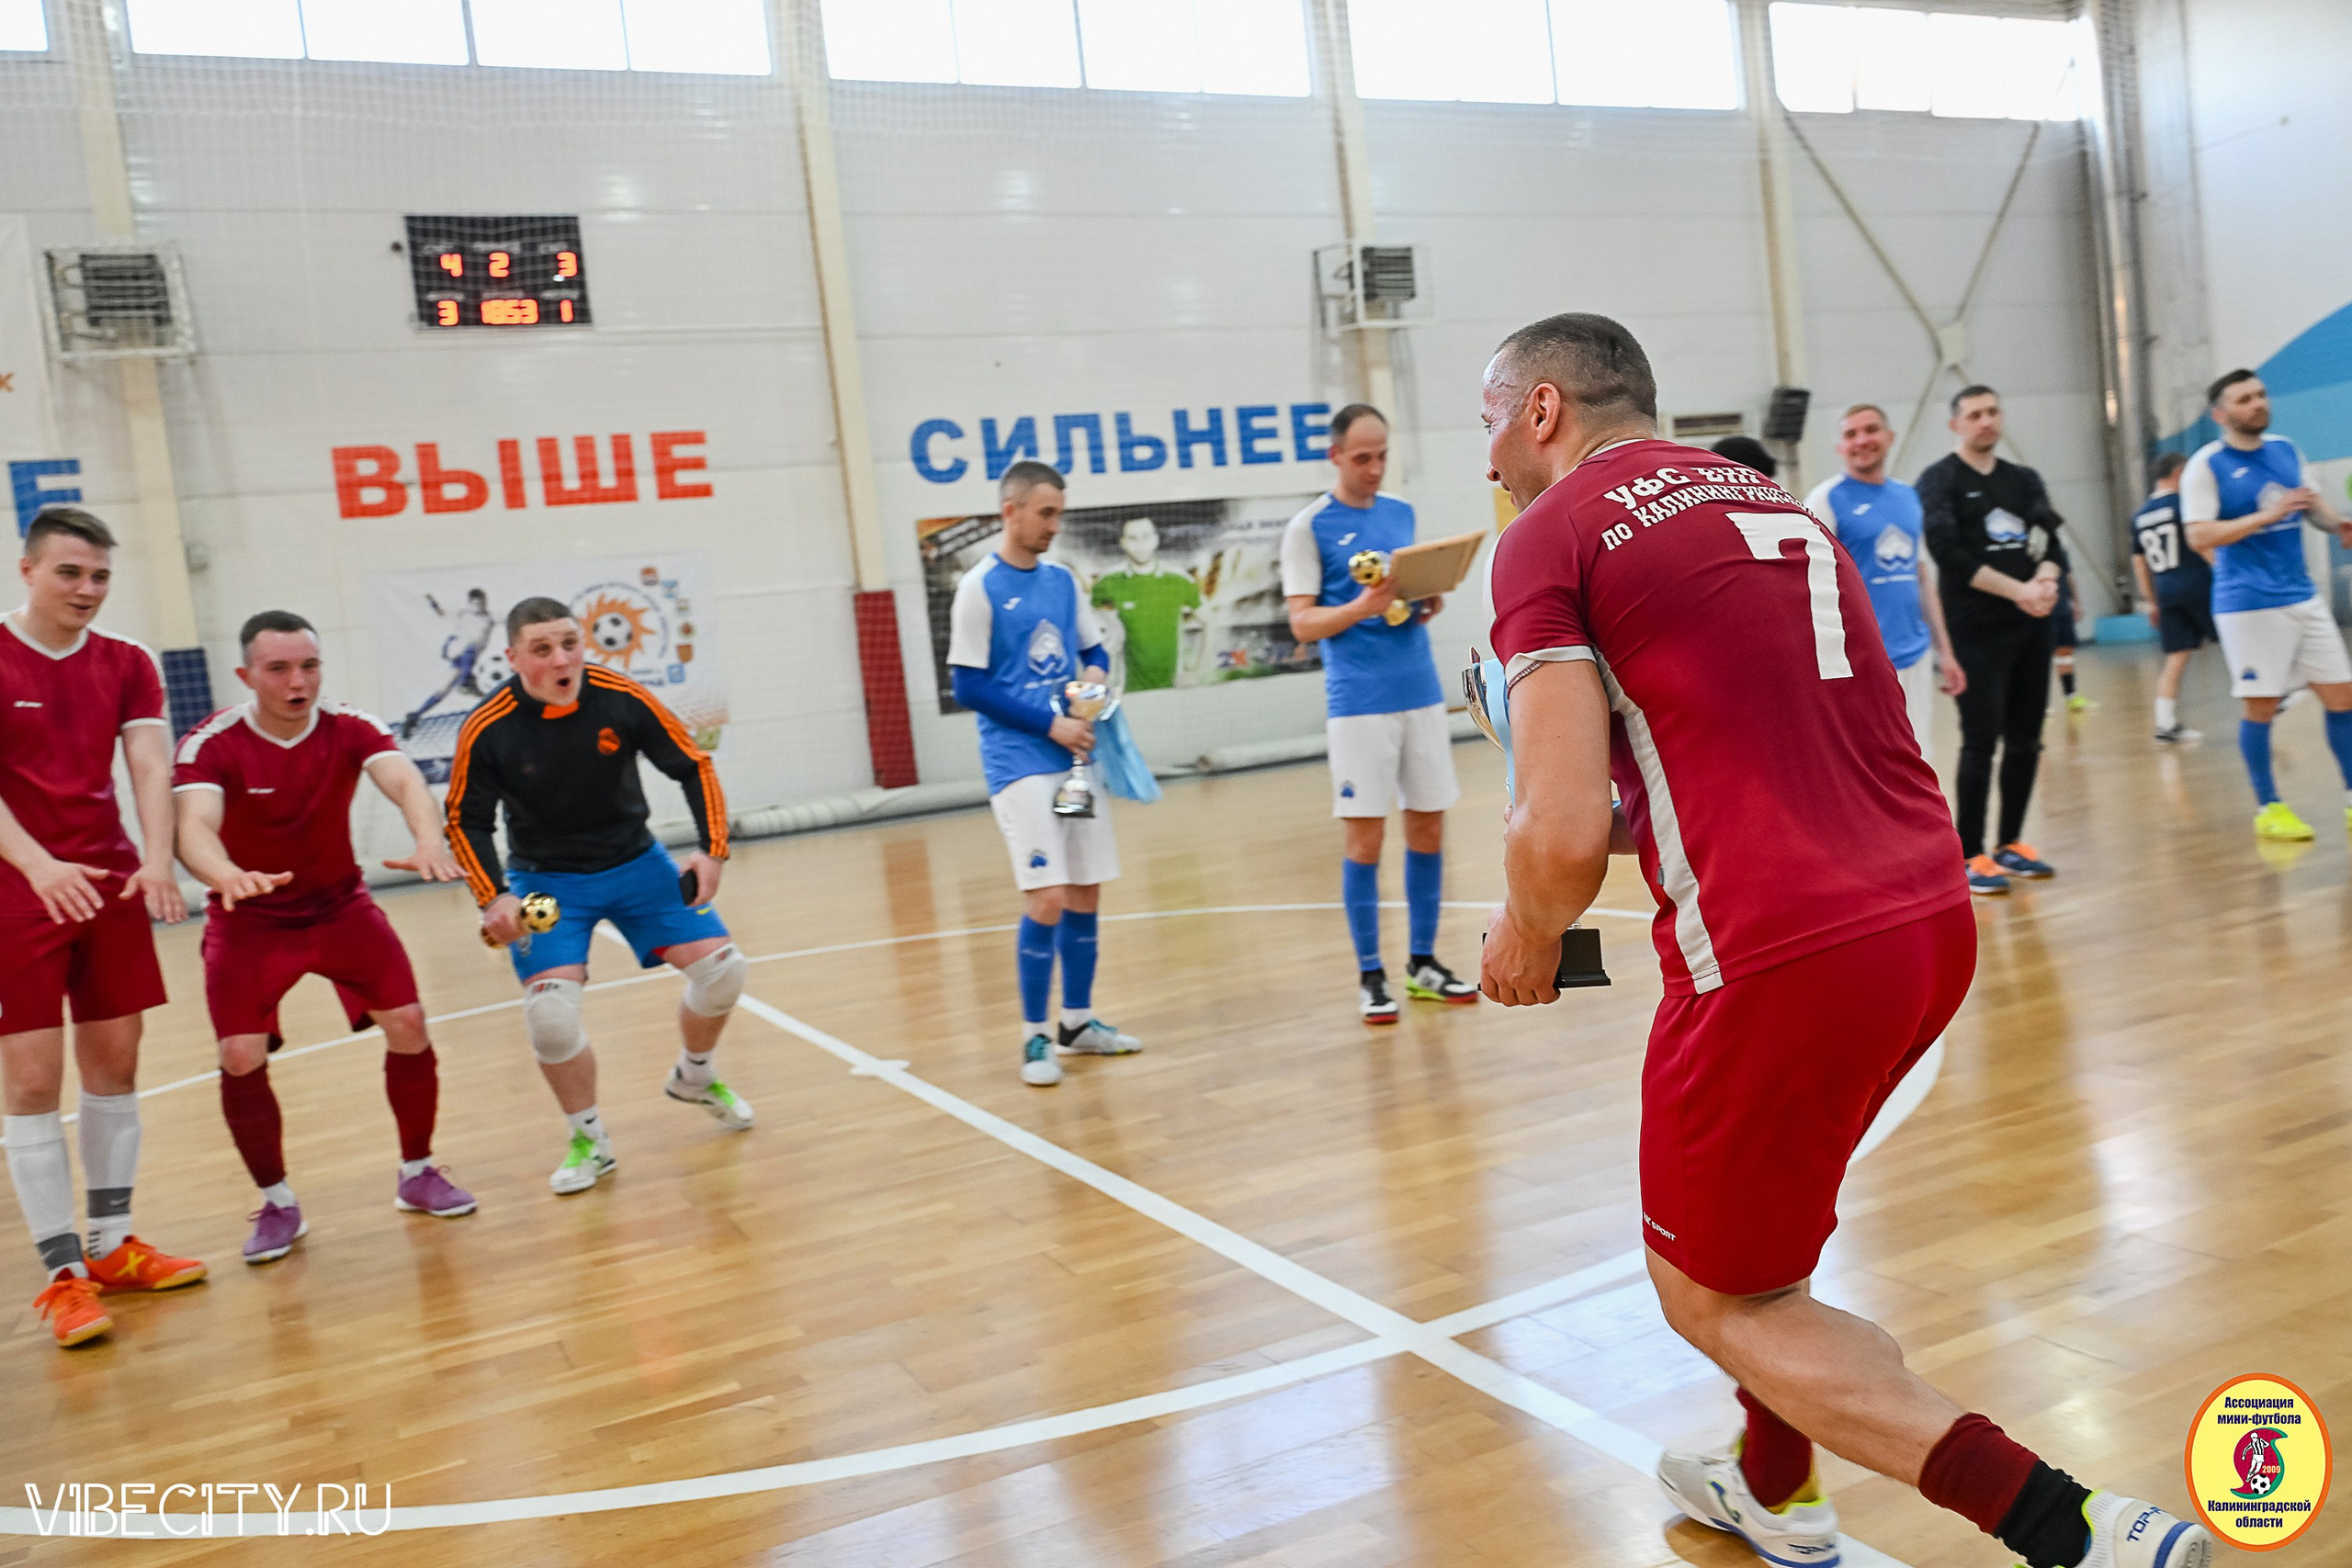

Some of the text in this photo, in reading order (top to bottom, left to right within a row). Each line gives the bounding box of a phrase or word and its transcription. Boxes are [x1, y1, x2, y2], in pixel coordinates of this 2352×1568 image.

[440, 251, 578, 278] 4 2 3
[437, 299, 459, 326] 3
[560, 299, 574, 323] 1
[910, 403, 1331, 484] СИЛЬНЕЕ
[331, 430, 714, 520] ВЫШЕ
[1603, 468, 1691, 510] УФС
[1601, 523, 1634, 551] ПО
[2139, 523, 2179, 572] 87
[1724, 512, 1854, 680] 7
[1651, 1221, 1677, 1241] SPORT
